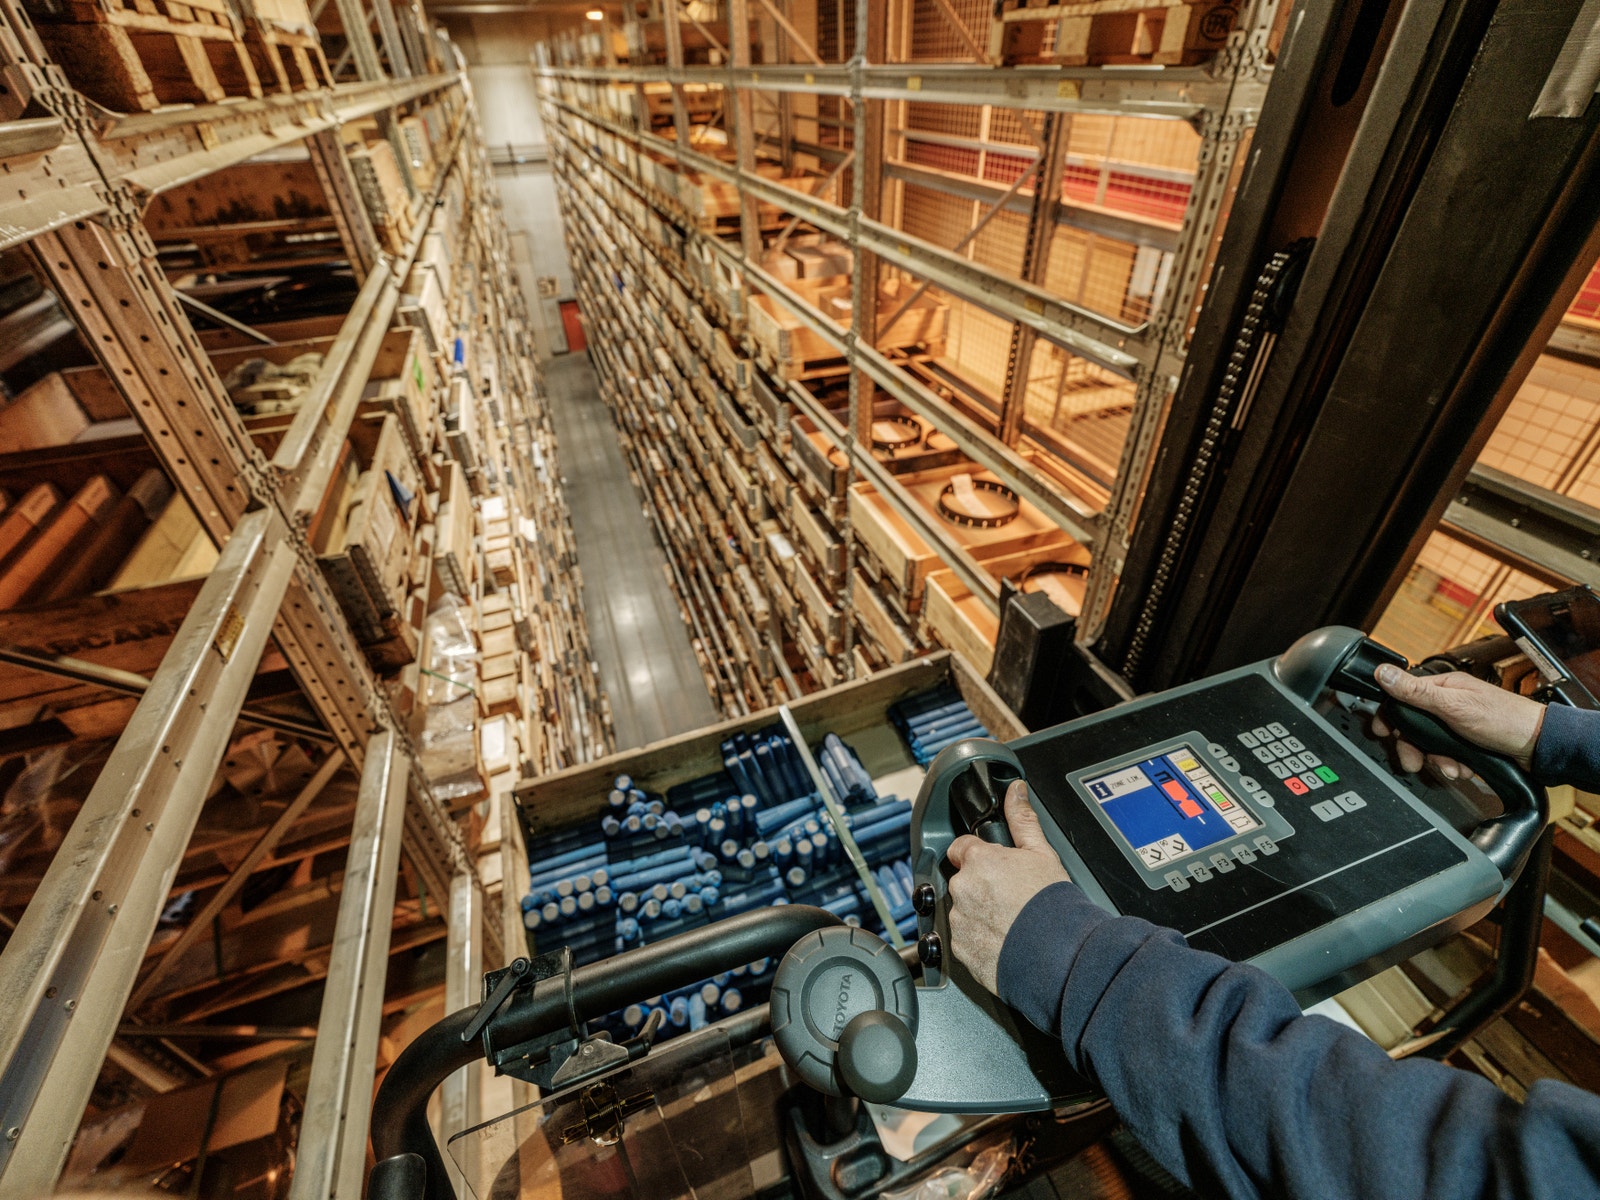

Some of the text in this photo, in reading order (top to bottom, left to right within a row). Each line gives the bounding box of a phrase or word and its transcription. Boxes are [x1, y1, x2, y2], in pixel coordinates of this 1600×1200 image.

[1258, 730, 1269, 739] 2
[1272, 725, 1283, 735] 3
[1260, 740, 1299, 759] 4 5 6
[1274, 754, 1315, 775] 7 8 9
[1344, 796, 1357, 806] C
[1260, 840, 1273, 851] F5
[1238, 849, 1251, 859] F4
[1216, 858, 1229, 868] F3
[1193, 867, 1207, 877] F2
[1171, 876, 1184, 887] F1
[832, 973, 853, 1032] TOYOTA
